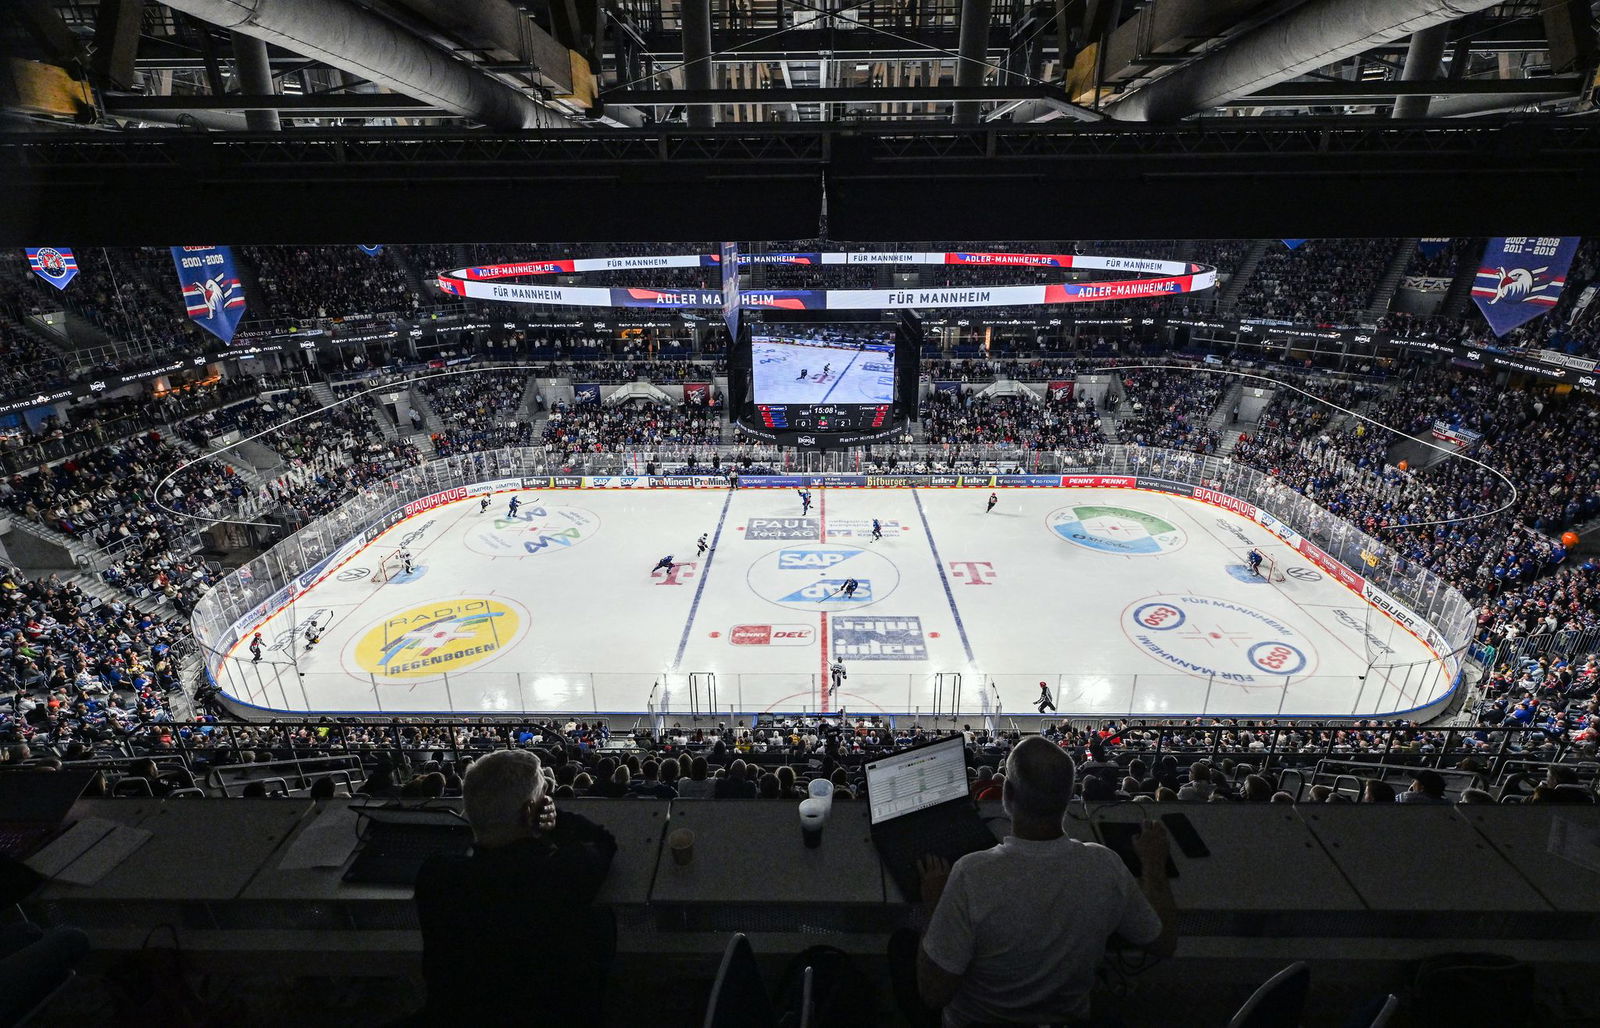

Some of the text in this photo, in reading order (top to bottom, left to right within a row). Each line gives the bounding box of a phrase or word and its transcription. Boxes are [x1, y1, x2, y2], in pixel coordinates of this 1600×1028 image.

[1503, 245, 1523, 254] 2011
[607, 258, 668, 268] FÜR MANNHEIM
[754, 255, 796, 263] MANNHEIM
[853, 254, 913, 262] FÜR MANNHEIM
[965, 255, 1052, 265] ADLER-MANNHEIM.DE
[479, 263, 555, 278] ADLER-MANNHEIM.DE
[1106, 259, 1163, 271] FÜR MANNHEIM
[493, 285, 562, 302] FÜR MANNHEIM
[1077, 281, 1175, 299] ADLER-MANNHEIM.DE
[656, 293, 774, 305] ADLER MAHEIM
[888, 290, 990, 305] FÜR MANNHEIM
[932, 477, 988, 485] inter inter
[405, 488, 467, 517] BAUHAUS
[523, 477, 547, 486] inter
[555, 477, 579, 486] inter
[593, 478, 608, 486] SAP
[620, 478, 636, 486] SAP
[650, 477, 692, 486] ProMinent
[1194, 488, 1256, 516] BAUHAUS
[752, 519, 815, 529] PAUL
[1262, 514, 1273, 526] SAP
[1280, 526, 1291, 538] SAP
[780, 553, 844, 567] SAP
[949, 561, 997, 585] T
[1180, 597, 1209, 606] FÜR
[389, 601, 484, 628] RADIO
[834, 621, 919, 636] inter
[773, 631, 809, 639] DEL
[834, 639, 925, 656] inter
[390, 643, 496, 676] REGENBOGEN
[1221, 672, 1255, 683] FÜR
